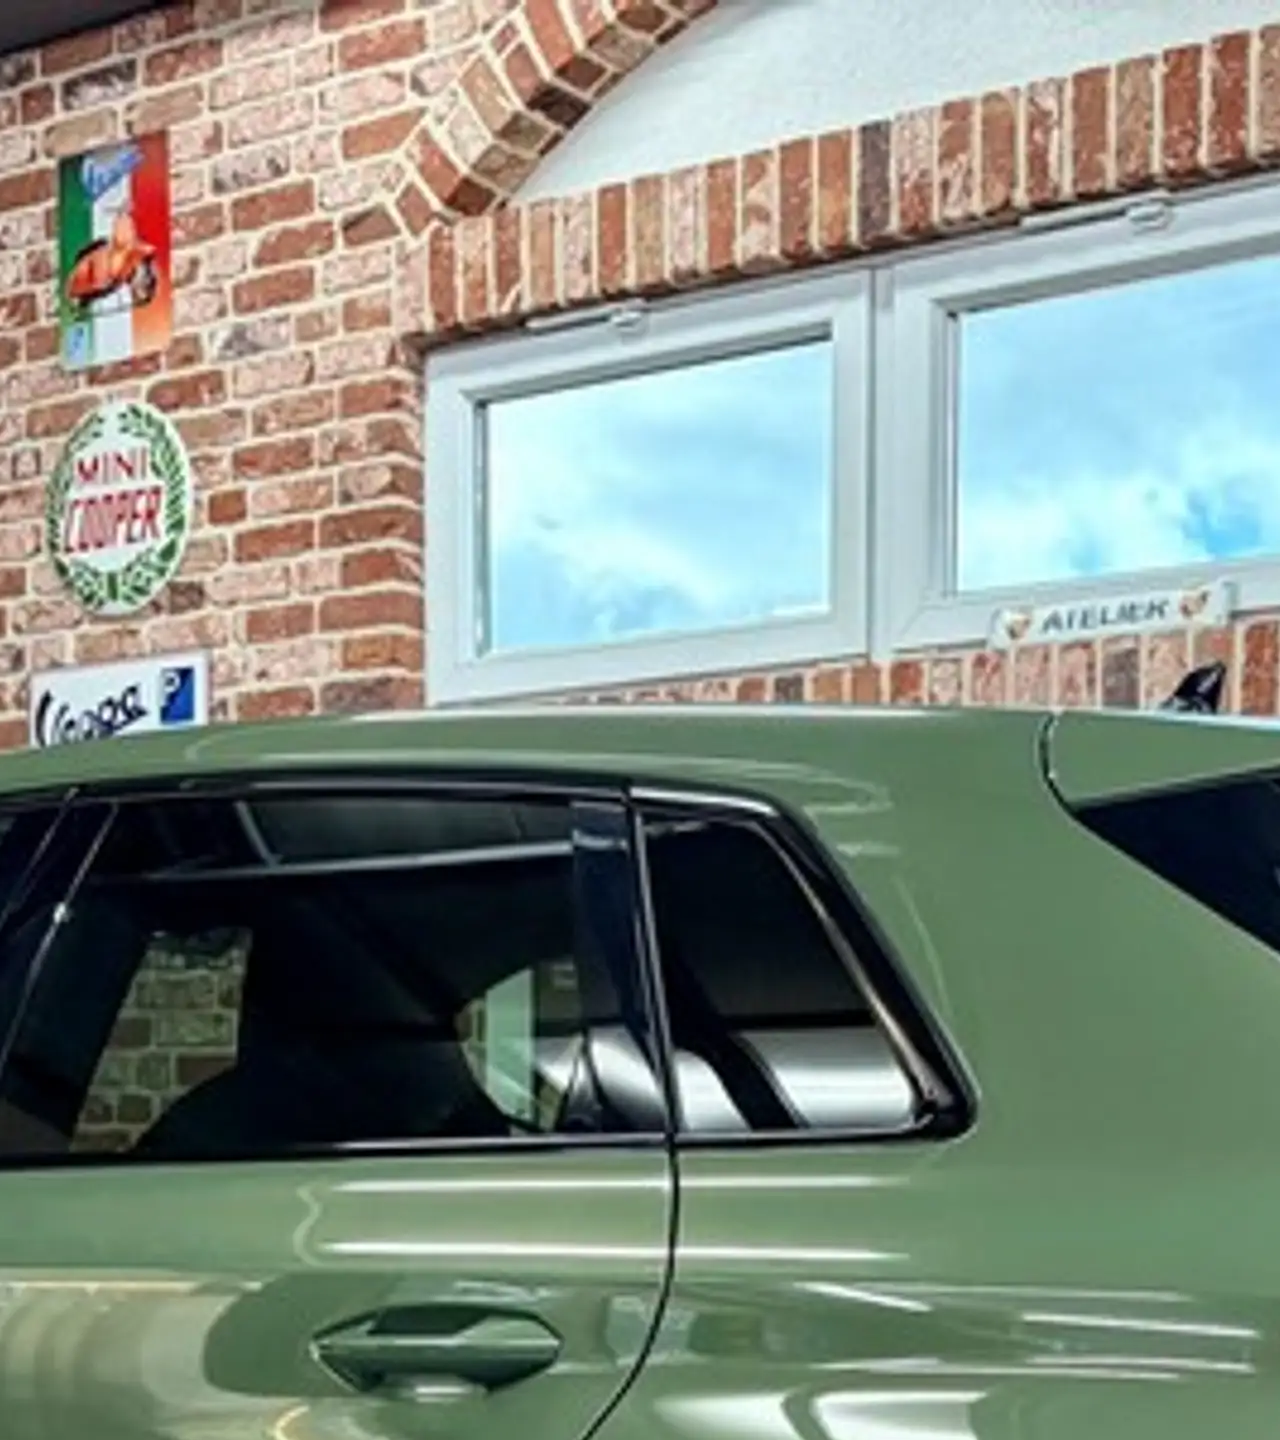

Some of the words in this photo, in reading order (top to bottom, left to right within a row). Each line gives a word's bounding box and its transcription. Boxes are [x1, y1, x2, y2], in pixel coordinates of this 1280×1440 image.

[74, 450, 149, 484] MINI
[64, 485, 163, 554] COOPER
[1041, 598, 1169, 634] ATELIER
